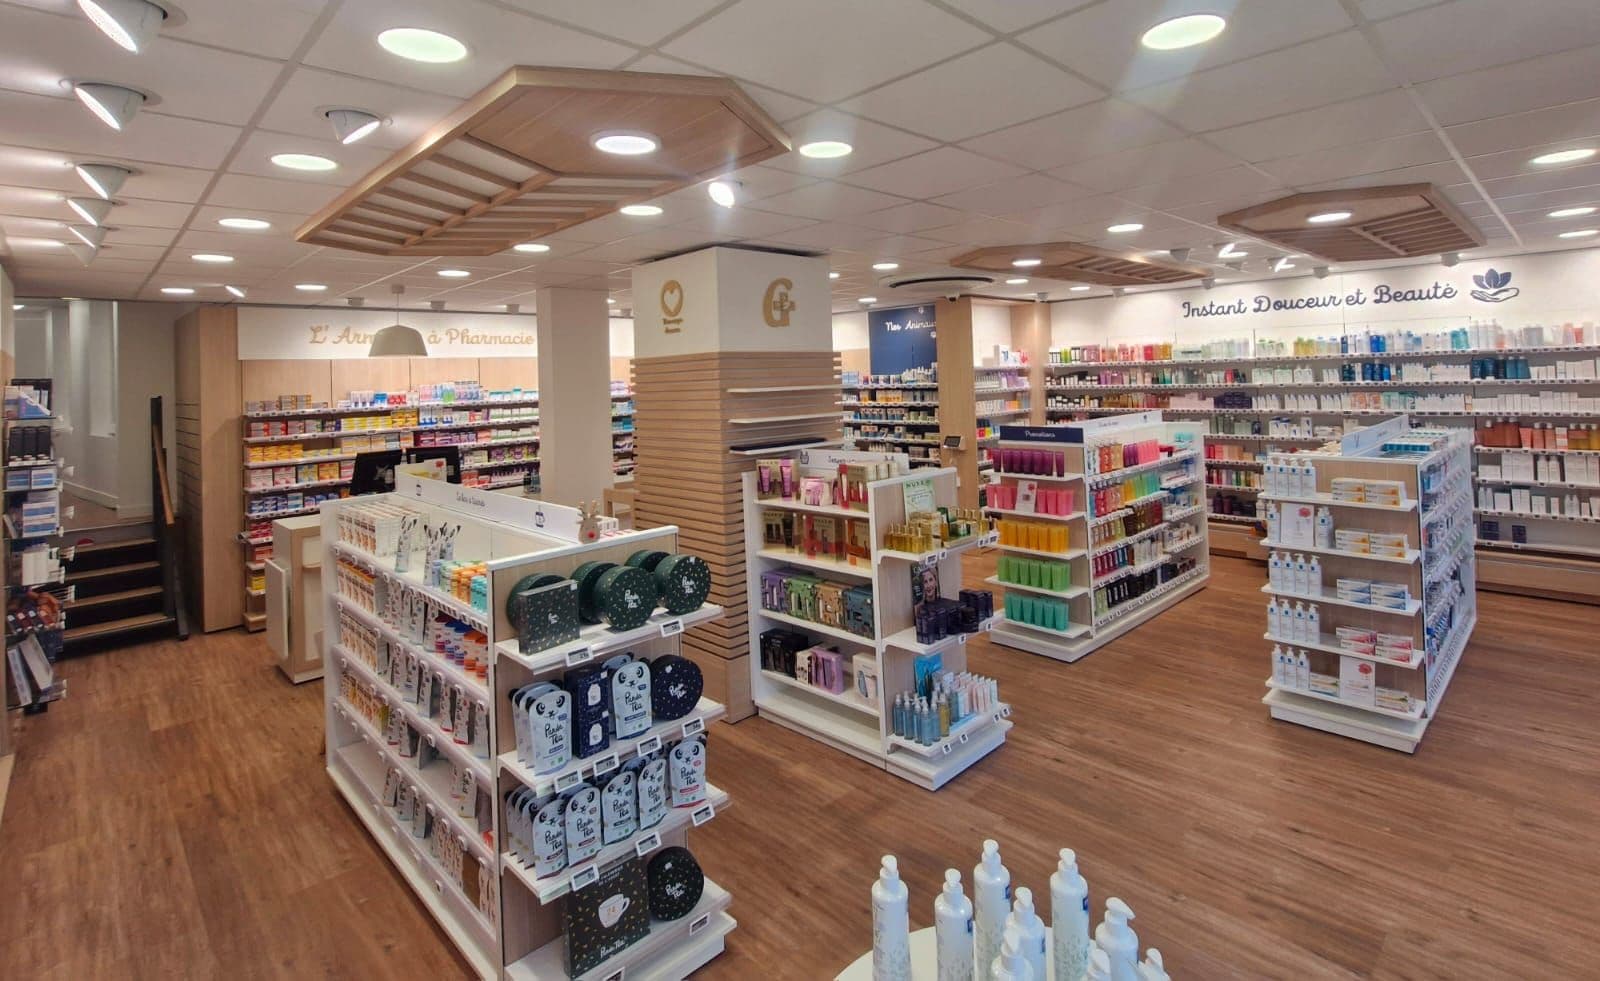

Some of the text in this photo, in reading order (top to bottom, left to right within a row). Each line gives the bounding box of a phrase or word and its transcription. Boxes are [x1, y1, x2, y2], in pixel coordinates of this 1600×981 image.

[1182, 281, 1458, 318] Instant Douceur et Beauté
[309, 325, 329, 345] L'
[427, 329, 442, 345] à
[445, 327, 535, 345] Pharmacie
[545, 723, 564, 738] Panda
[549, 733, 564, 745] Tea
[681, 766, 697, 779] Panda
[685, 776, 697, 786] Tea
[612, 799, 629, 813] Panda
[618, 807, 630, 818] Tea
[577, 818, 594, 831] Panda
[545, 830, 563, 844] Panda
[581, 827, 594, 838] Tea
[550, 840, 563, 851] Tea
